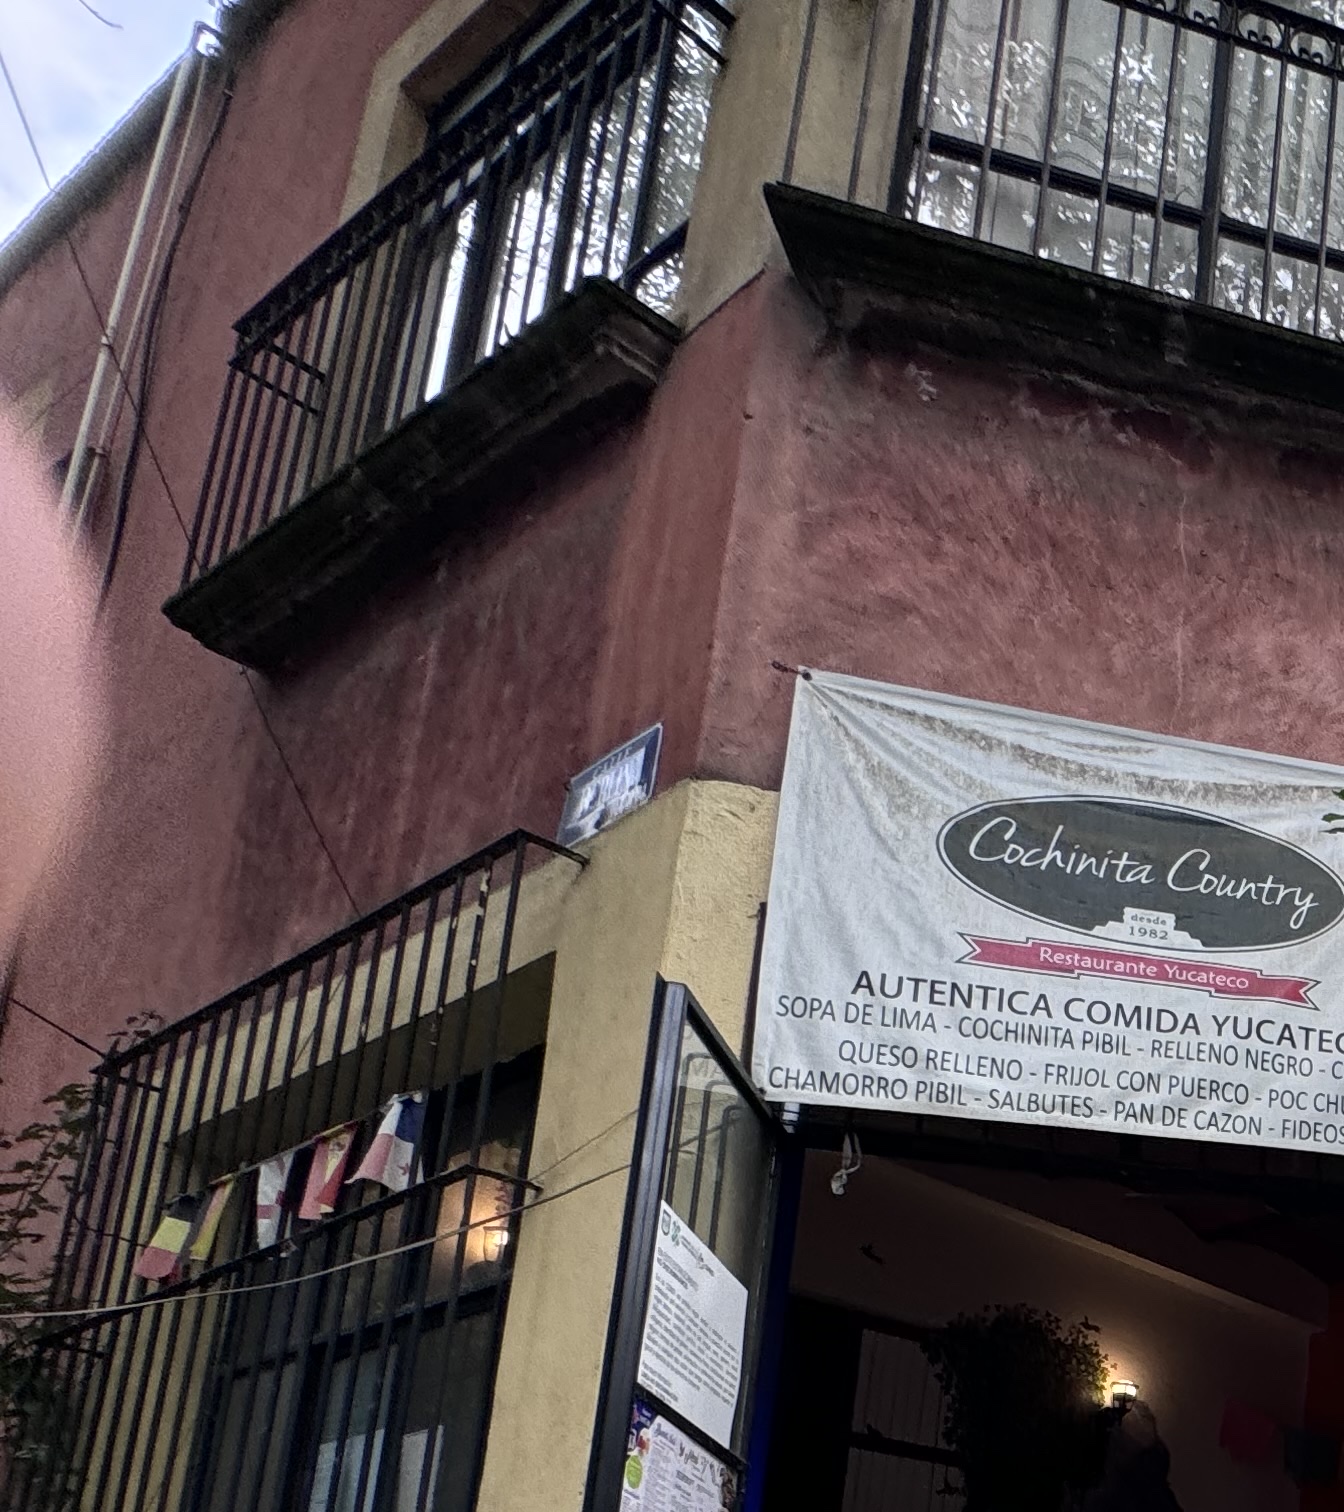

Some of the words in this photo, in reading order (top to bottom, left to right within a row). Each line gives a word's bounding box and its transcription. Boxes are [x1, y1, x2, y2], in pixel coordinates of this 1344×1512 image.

[968, 816, 1155, 884] Cochinita
[1166, 848, 1320, 929] Country
[1127, 925, 1170, 941] 1982
[1130, 912, 1168, 927] desde
[850, 969, 1054, 1019] AUTENTICA
[1063, 997, 1202, 1037] COMIDA
[1038, 947, 1158, 977] Restaurante
[1163, 963, 1250, 990] Yucateco
[775, 993, 836, 1022] SOPA
[843, 1002, 873, 1026] DE
[880, 1006, 938, 1034] LIMA
[957, 1015, 1075, 1051] COCHINITA
[1082, 1029, 1132, 1058] PIBIL
[1150, 1038, 1239, 1068] RELLENO
[1245, 1048, 1314, 1078] NEGRO
[767, 1065, 908, 1100] CHAMORRO
[915, 1078, 968, 1107] PIBIL
[987, 1087, 1094, 1119] SALBUTES
[1113, 1100, 1154, 1126] PAN
[1161, 1106, 1187, 1129] DE
[1193, 1110, 1262, 1136] CAZON
[838, 1039, 918, 1069] QUESO
[925, 1047, 1023, 1081] RELLENO
[1043, 1062, 1111, 1089] FRIJOL
[1116, 1070, 1164, 1096] CON
[1168, 1074, 1250, 1106] PUERCO
[1267, 1088, 1310, 1112] POC
